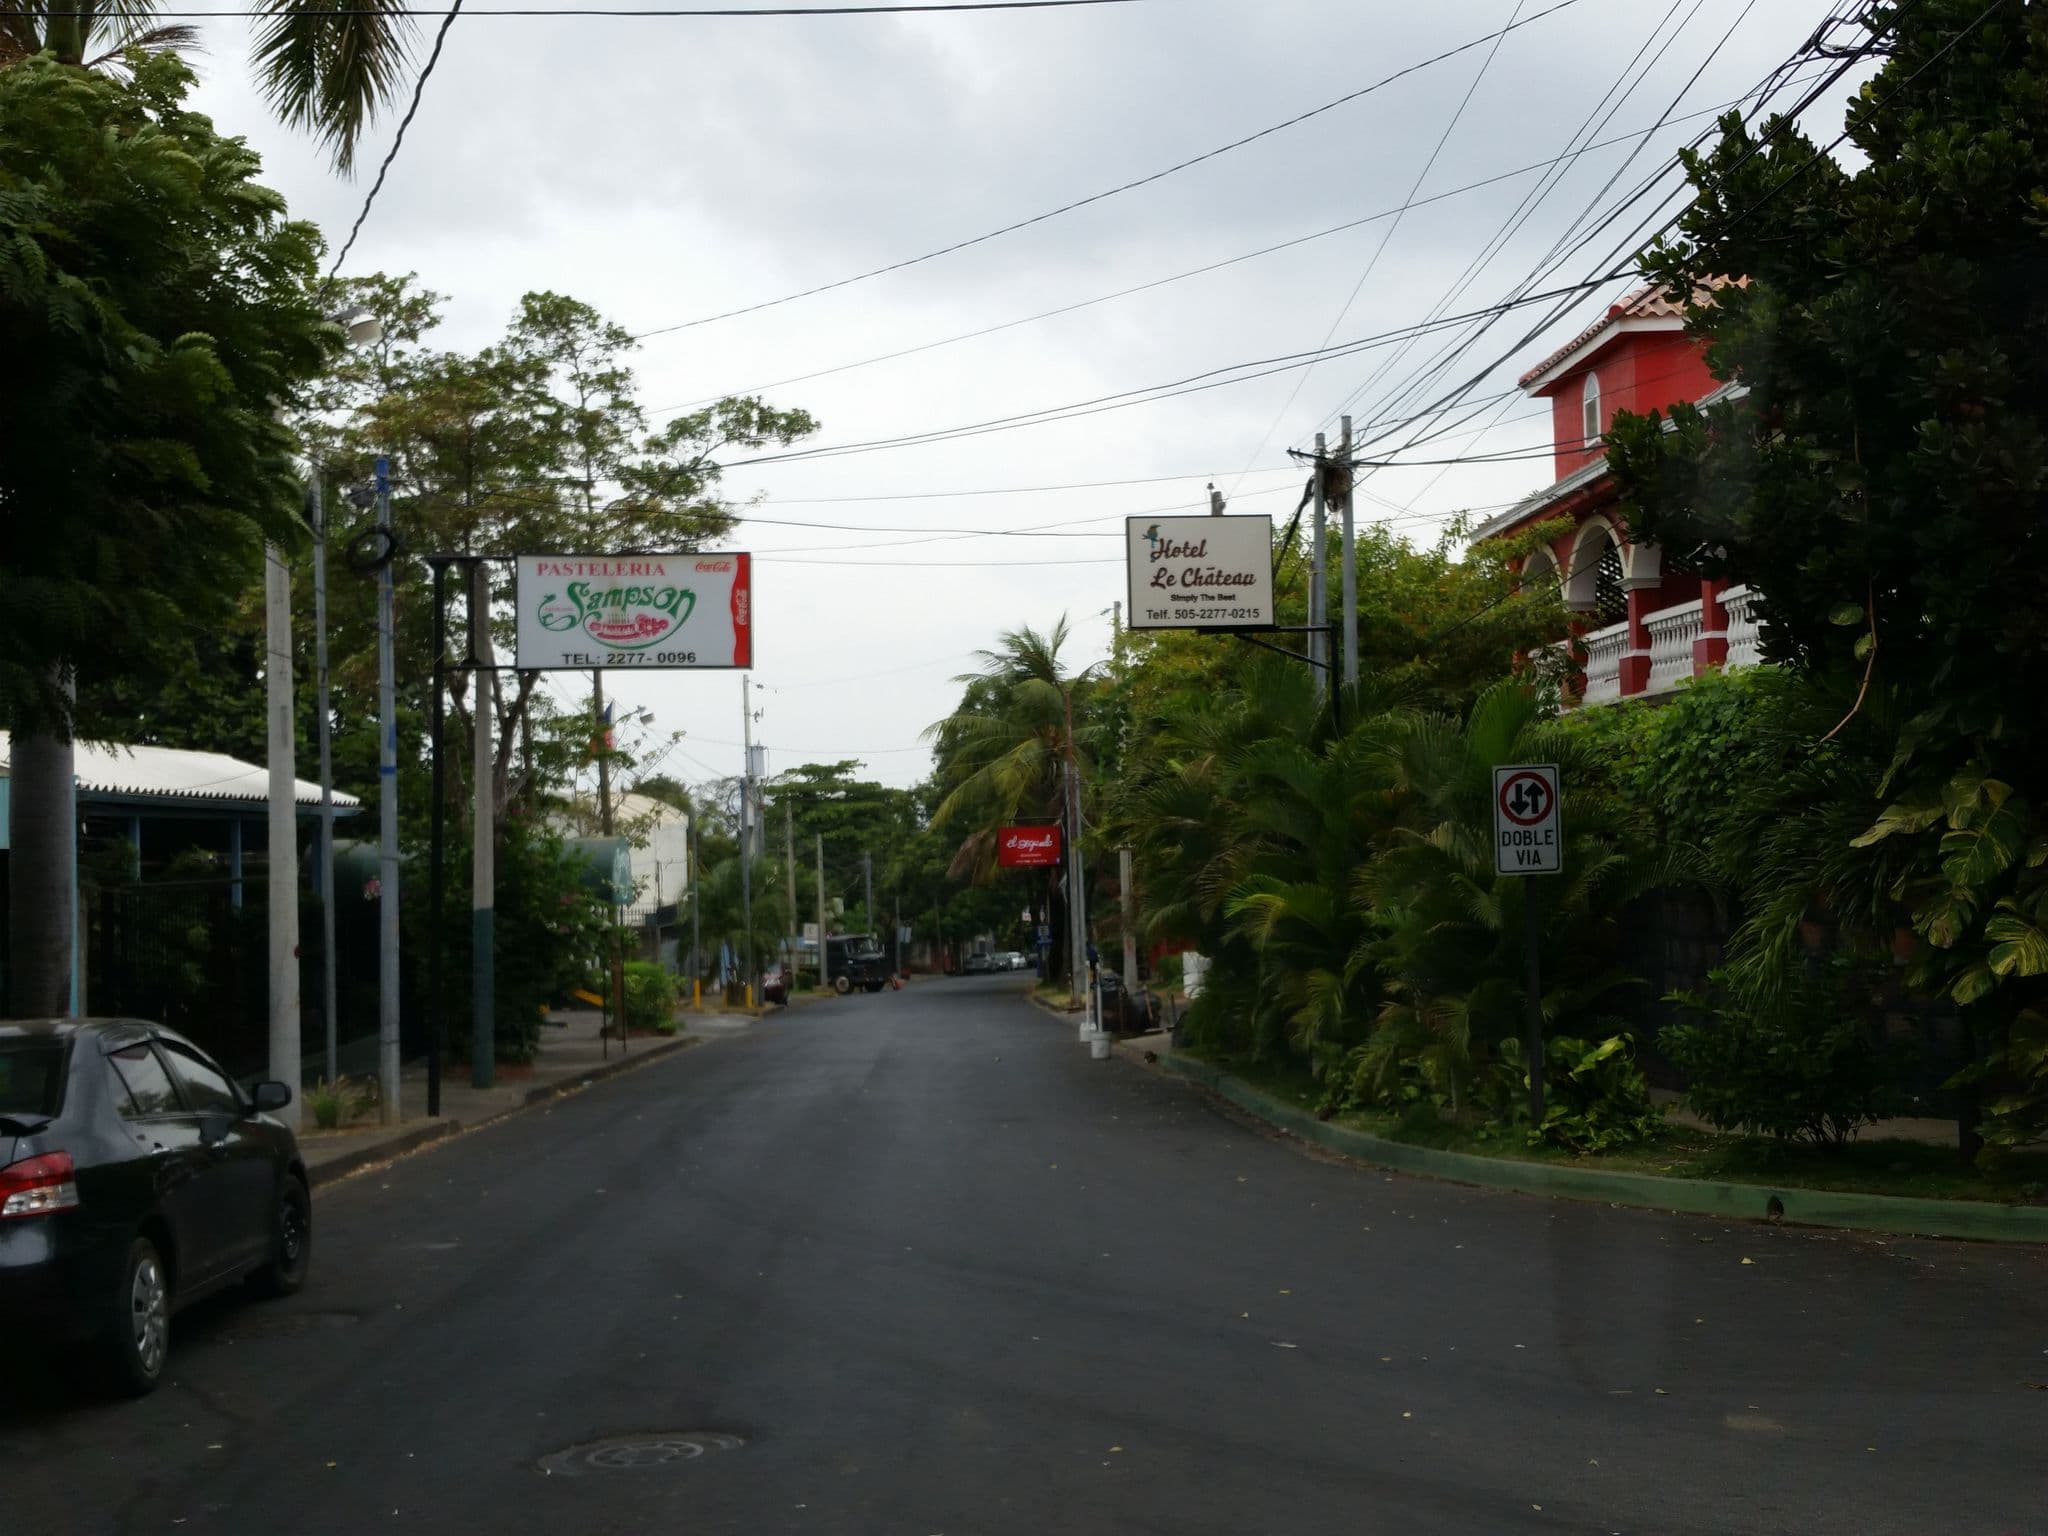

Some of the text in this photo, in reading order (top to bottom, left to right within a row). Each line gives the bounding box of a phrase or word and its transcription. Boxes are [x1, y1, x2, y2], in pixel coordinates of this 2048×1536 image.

[1151, 538, 1207, 560] Hotel
[536, 561, 666, 577] PASTELERIA
[695, 560, 733, 573] Coca-Cola
[1150, 567, 1177, 589] Le
[1170, 593, 1236, 603] Simply The Best
[538, 580, 697, 633] Sampson
[1175, 608, 1260, 620] 505-2277-0215
[562, 653, 600, 665] TEL:
[1502, 829, 1554, 847] DOBLE
[1516, 849, 1542, 865] VIA
